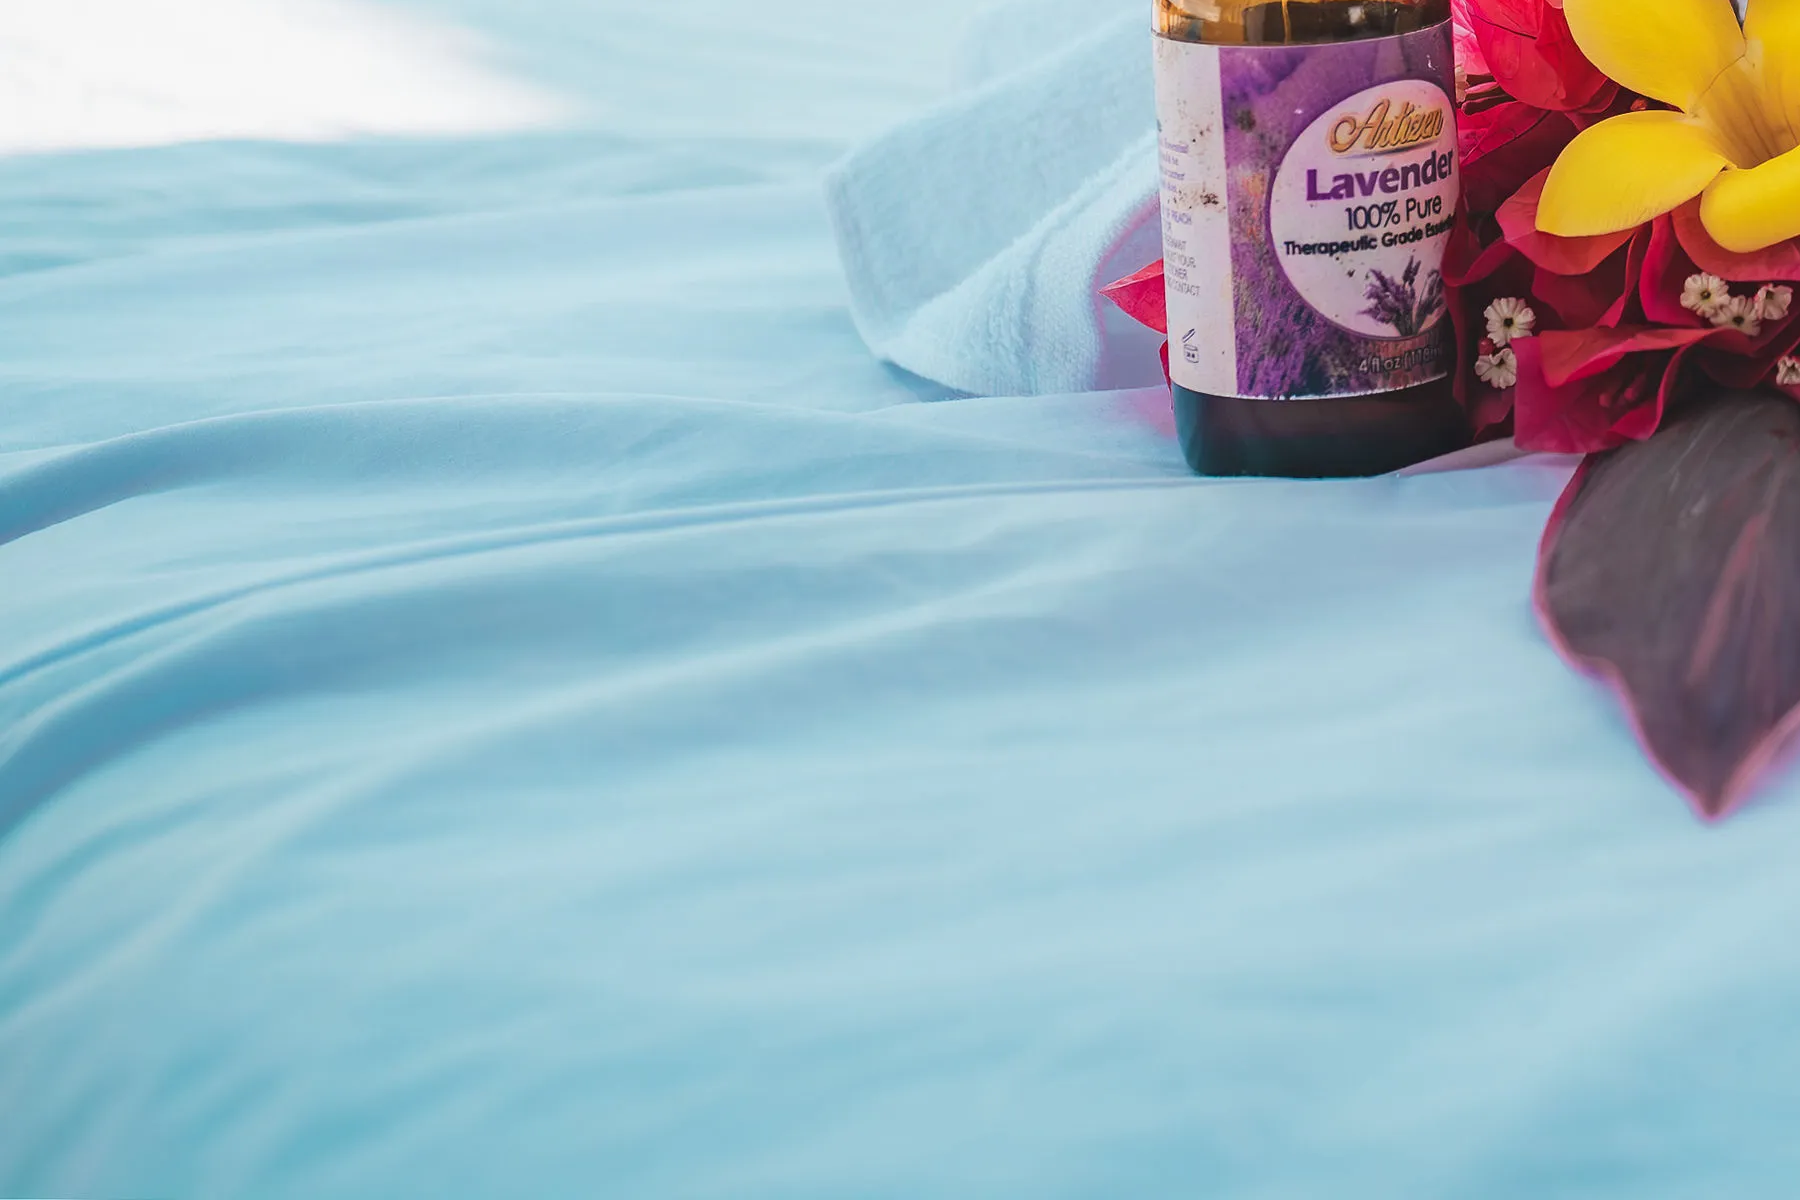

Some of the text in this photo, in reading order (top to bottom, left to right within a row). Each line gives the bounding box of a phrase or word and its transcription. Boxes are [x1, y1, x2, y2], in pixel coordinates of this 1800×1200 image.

[1306, 150, 1454, 201] Lavender
[1345, 195, 1442, 231] 100% Pure
[1284, 234, 1378, 257] Therapeutic
[1381, 225, 1423, 248] Grade
[1359, 359, 1368, 373] 4
[1384, 356, 1401, 371] oz
